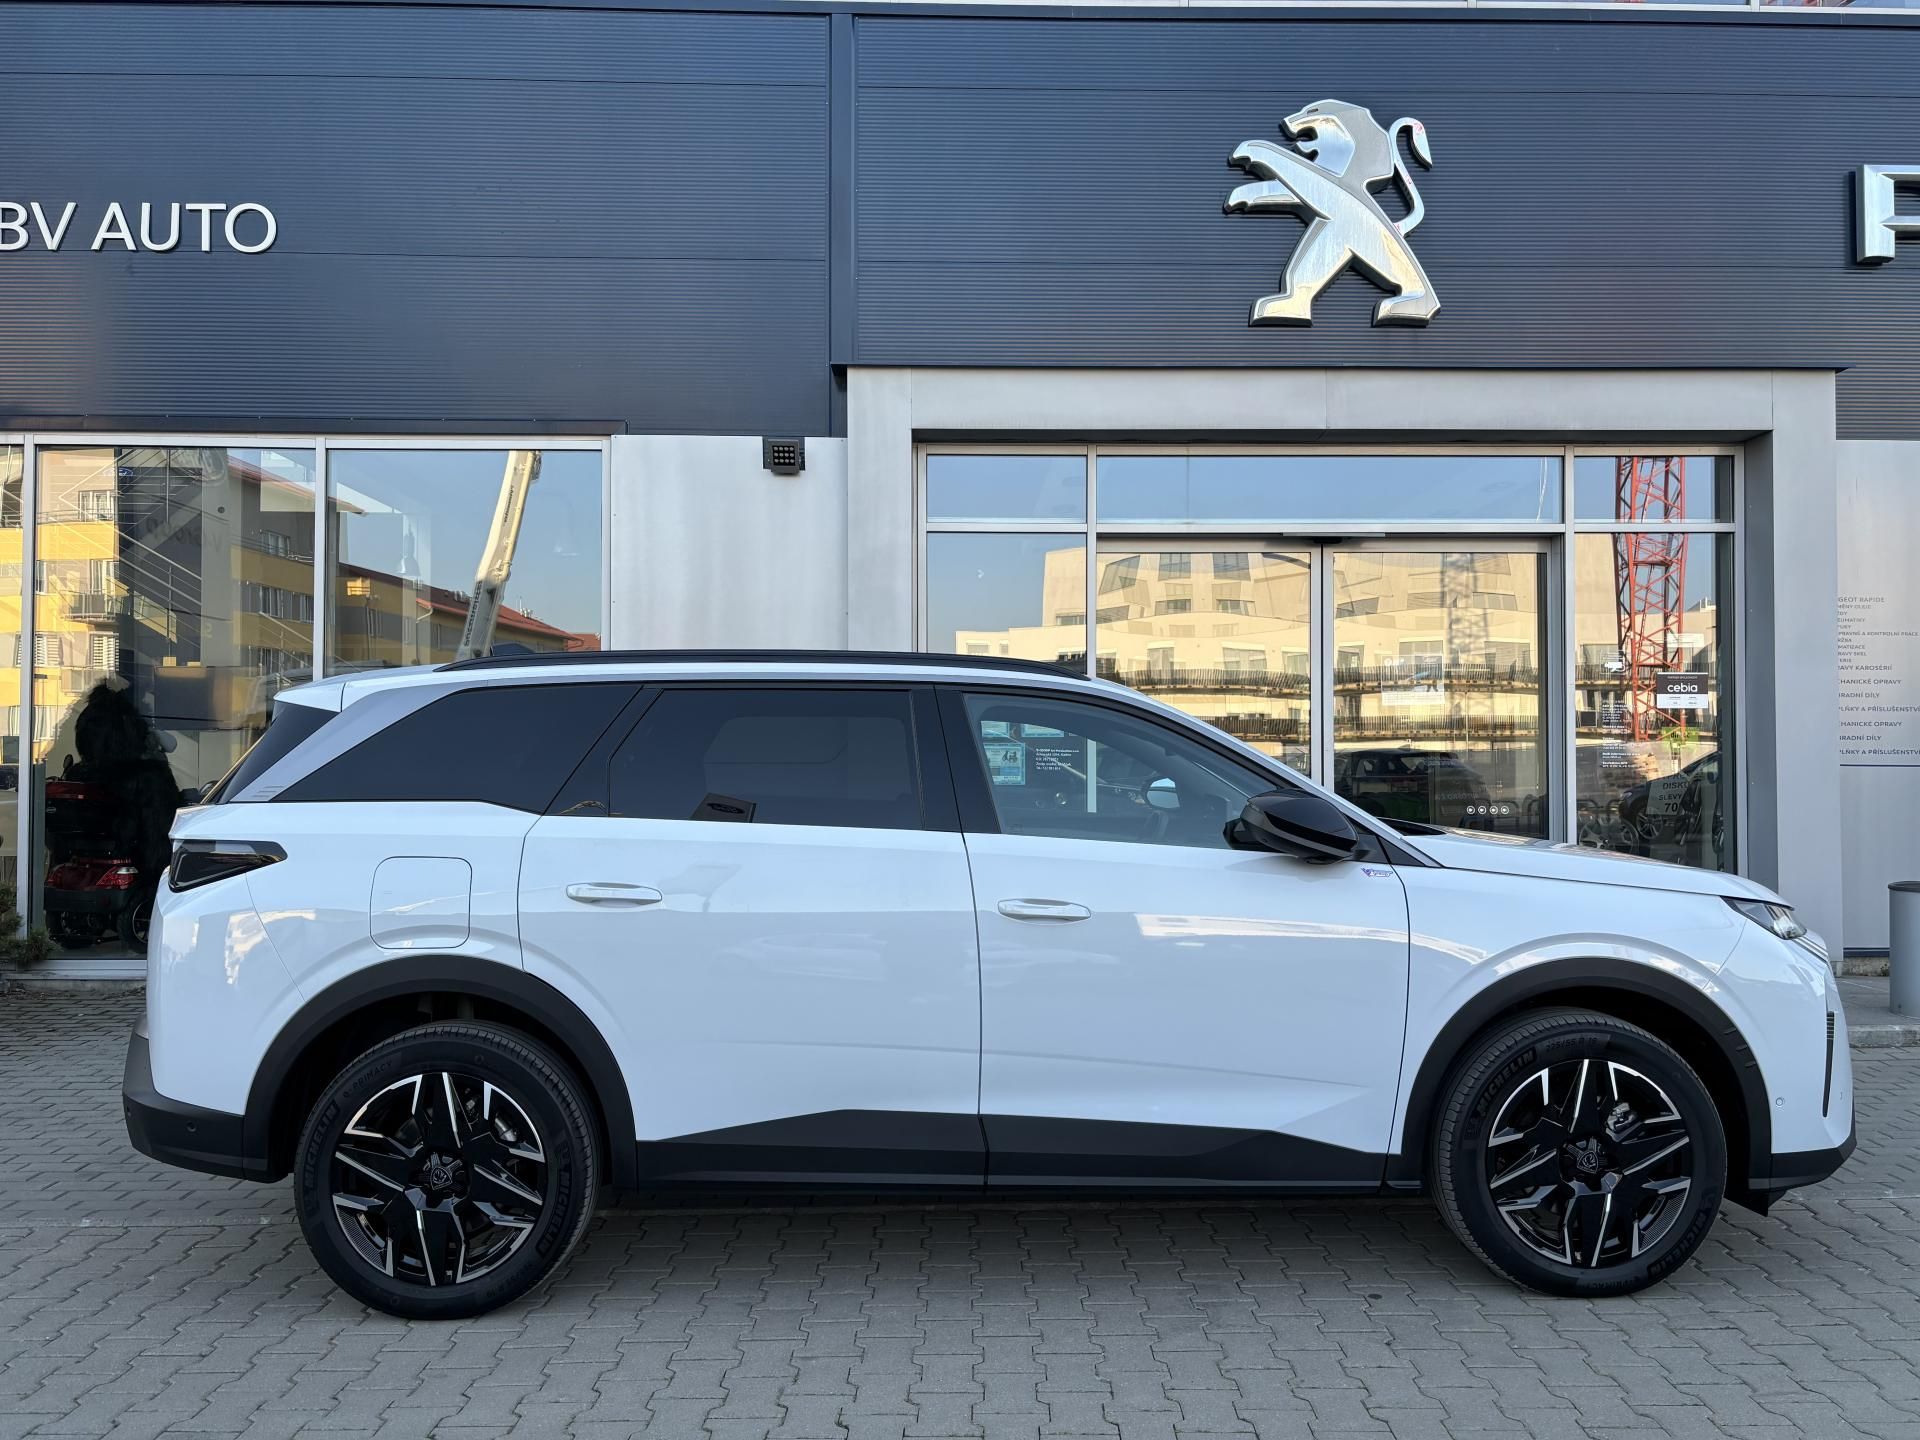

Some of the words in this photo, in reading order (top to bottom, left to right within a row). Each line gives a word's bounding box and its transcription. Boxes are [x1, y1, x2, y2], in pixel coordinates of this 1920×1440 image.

[90, 202, 278, 253] AUTO
[1667, 682, 1698, 693] cebia
[1476, 1048, 1536, 1117] MICHELIN
[304, 1100, 339, 1191] MICHELIN
[537, 1164, 573, 1257] MICHELIN
[1647, 1209, 1708, 1278] MICHELIN
